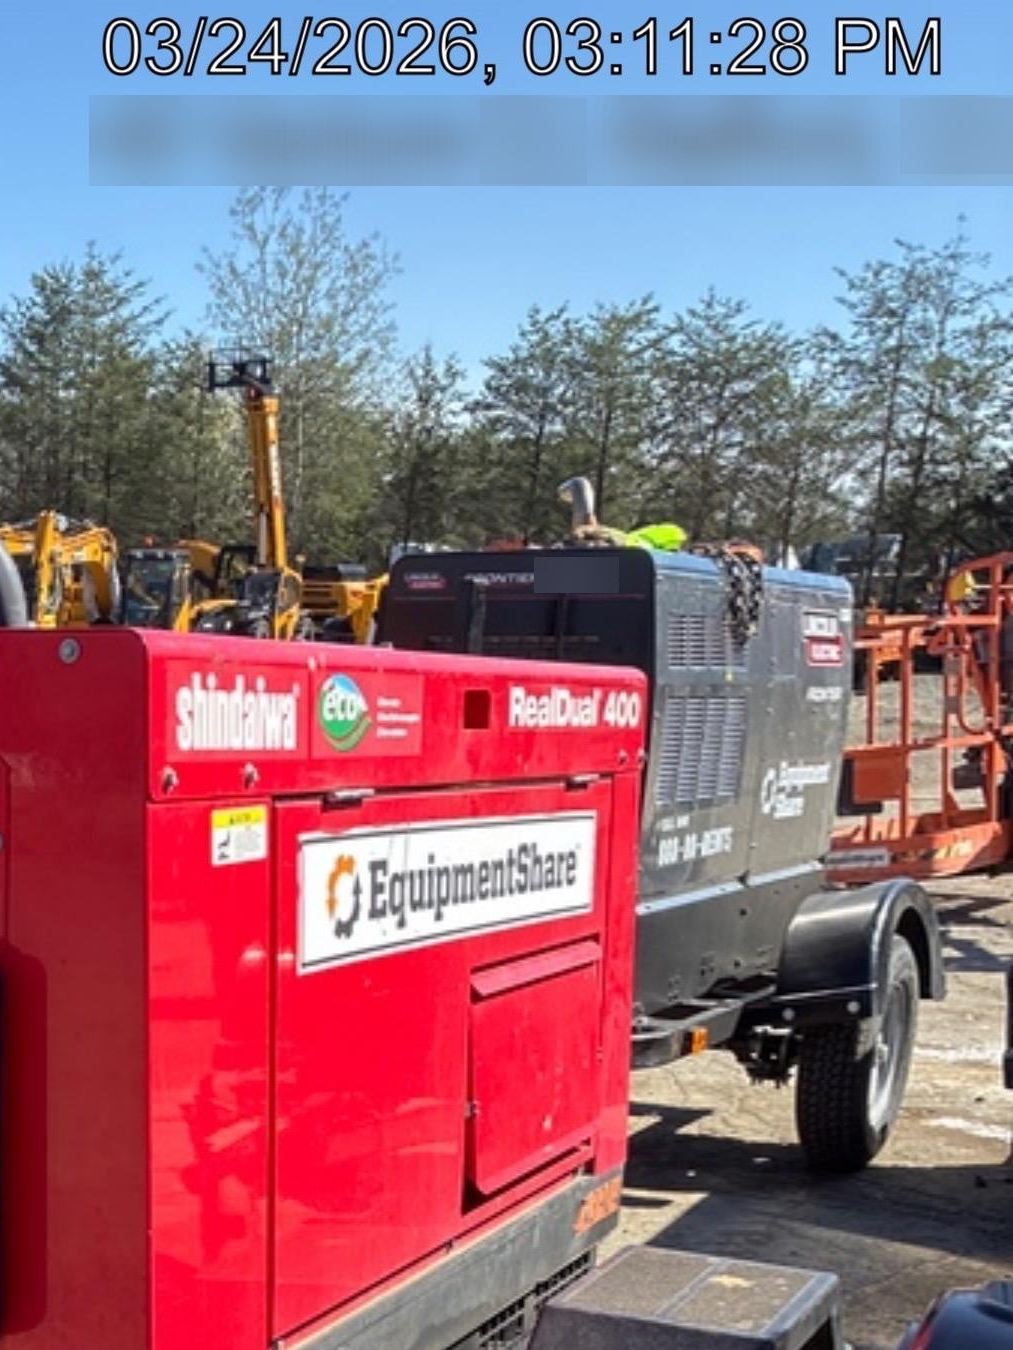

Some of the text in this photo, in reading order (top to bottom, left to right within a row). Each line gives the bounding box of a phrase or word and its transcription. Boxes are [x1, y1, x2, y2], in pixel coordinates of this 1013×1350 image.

[176, 672, 297, 750] shindaiwa
[323, 692, 358, 721] eco
[509, 686, 640, 727] RealDual 400
[368, 843, 577, 928] EquipmentShare
